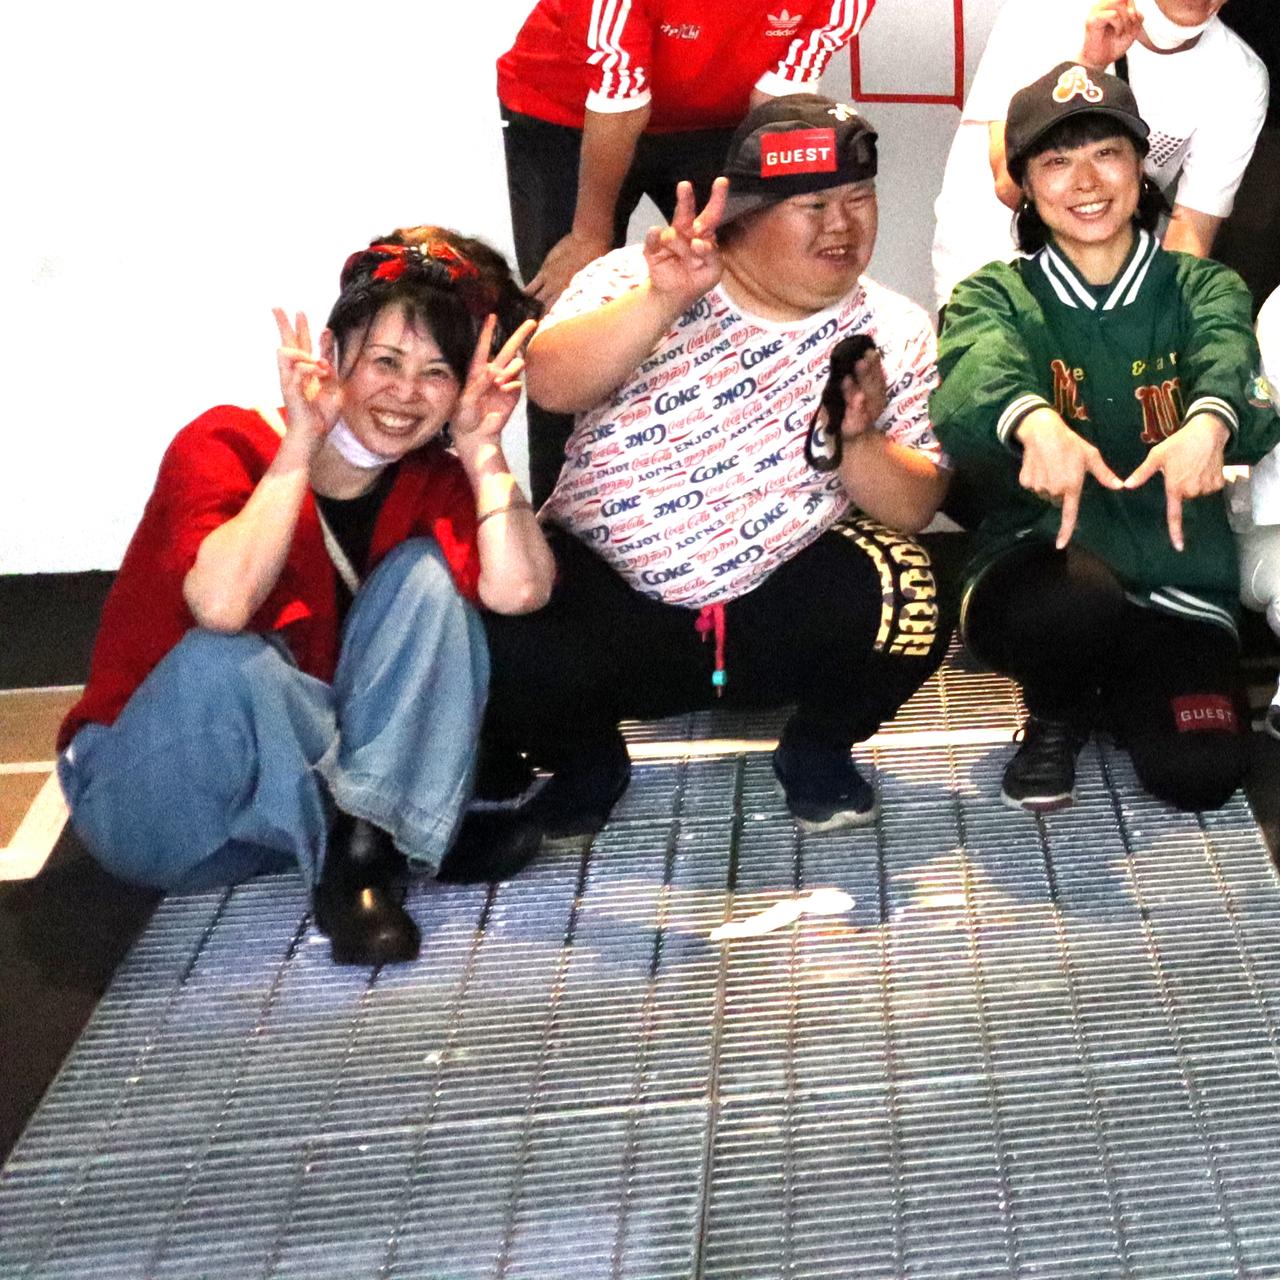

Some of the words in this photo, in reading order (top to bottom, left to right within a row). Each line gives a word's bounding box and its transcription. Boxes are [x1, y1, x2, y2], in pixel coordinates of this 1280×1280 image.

[764, 28, 798, 38] adida
[765, 147, 831, 167] GUEST
[796, 318, 838, 356] Coke
[640, 343, 685, 373] ENJOY
[693, 338, 732, 368] ENJOY
[740, 339, 784, 370] Coke
[655, 384, 700, 415] Coke
[712, 376, 757, 410] Coke
[596, 462, 630, 480] ENJOY
[674, 424, 720, 453] ENJOY
[763, 368, 806, 401] ENJOY
[624, 423, 667, 449] Coke
[730, 408, 773, 440] ENJOY
[638, 460, 683, 483] ENJOY
[690, 454, 740, 484] Coke
[600, 494, 641, 518] Coke
[653, 489, 704, 519] Coke
[676, 519, 726, 551] ENJOY
[740, 501, 789, 540] Coke
[616, 531, 662, 554] ENJOY
[641, 562, 695, 585] Coke
[711, 544, 765, 577] Coke
[1180, 707, 1232, 723] GUEST
